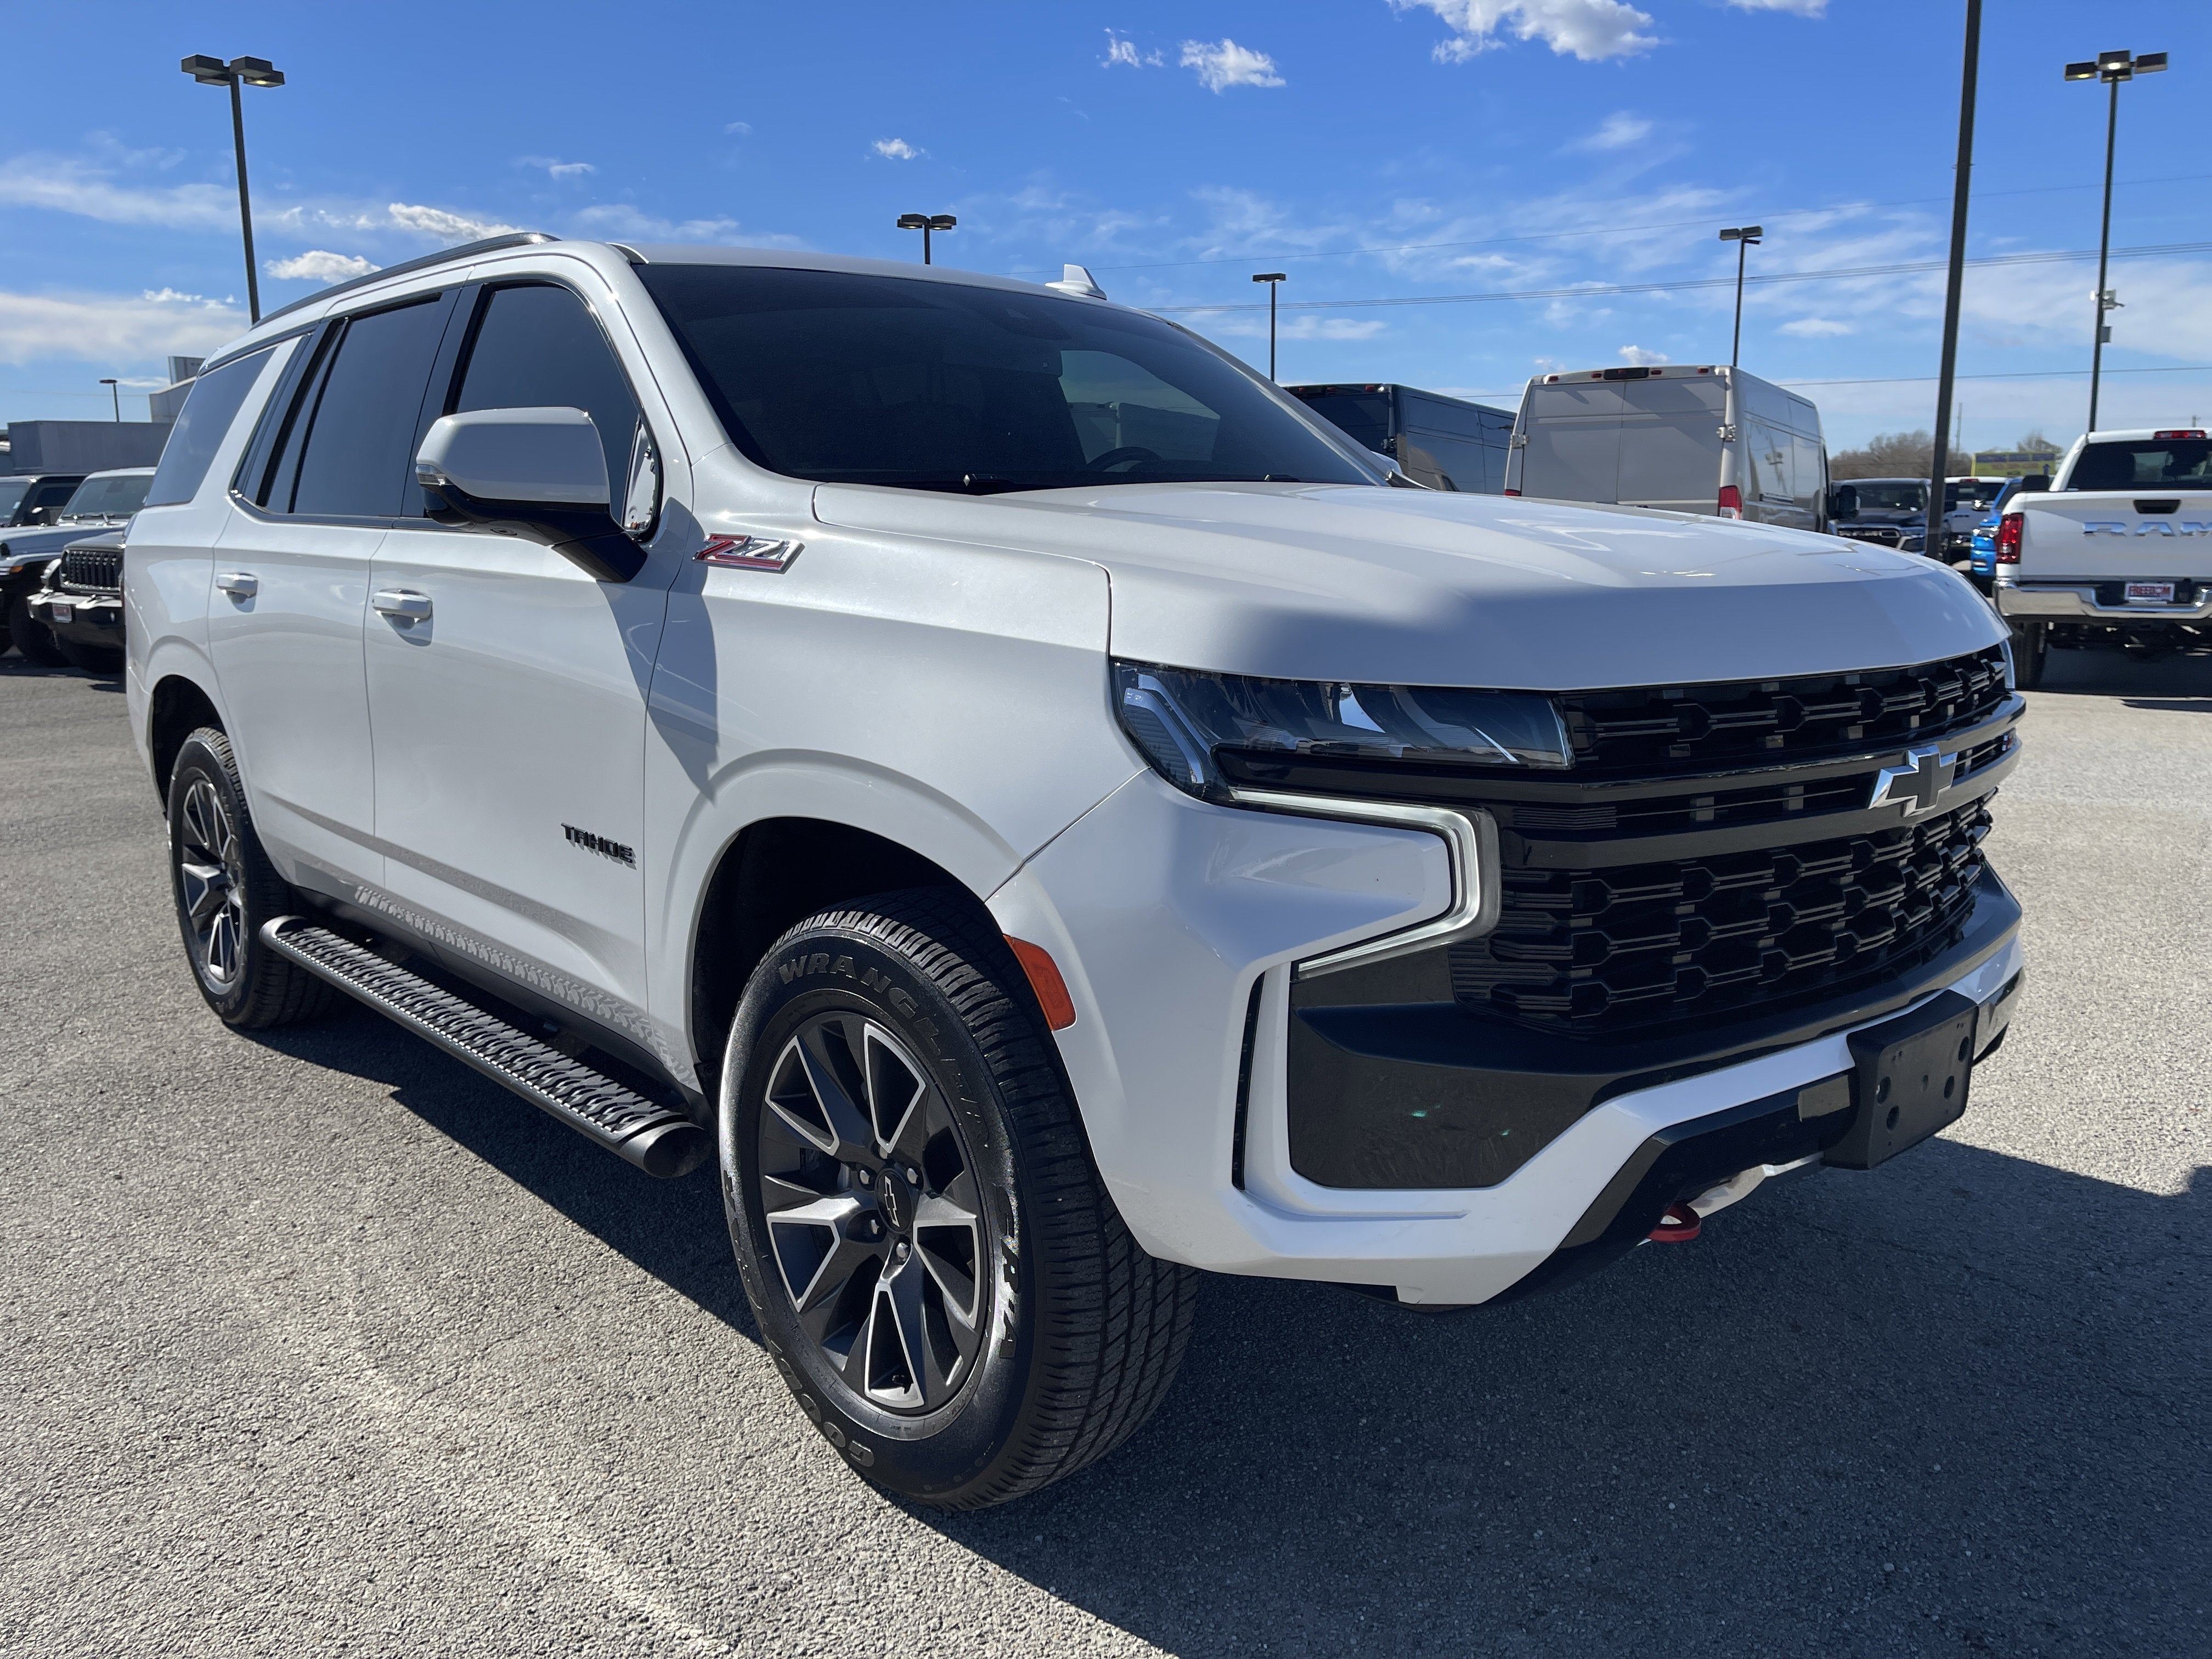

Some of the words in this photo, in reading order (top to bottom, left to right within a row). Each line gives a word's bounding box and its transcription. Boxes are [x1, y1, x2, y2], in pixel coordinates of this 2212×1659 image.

[2082, 522, 2212, 536] RAM
[692, 533, 805, 574] Z71
[561, 823, 633, 863] TAHOE
